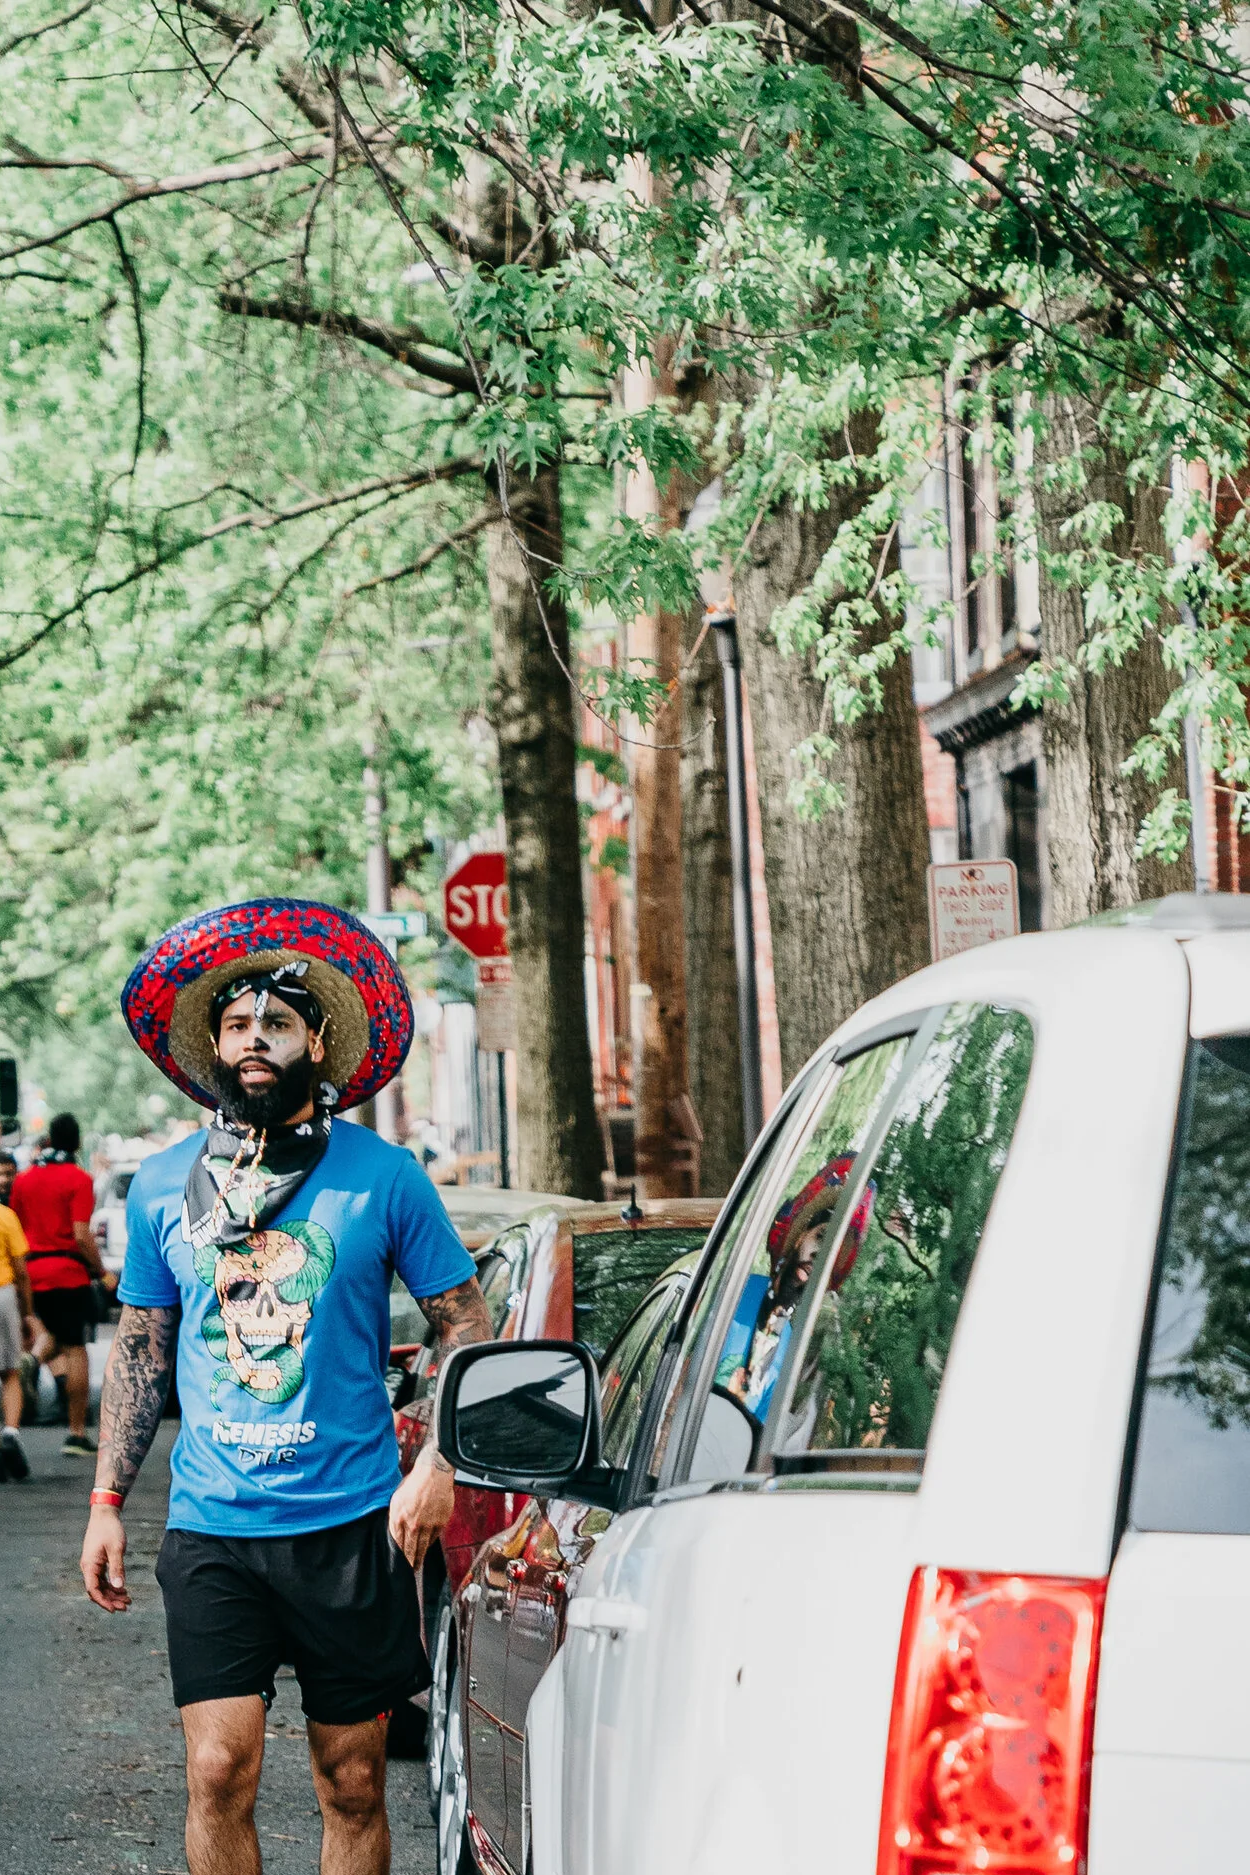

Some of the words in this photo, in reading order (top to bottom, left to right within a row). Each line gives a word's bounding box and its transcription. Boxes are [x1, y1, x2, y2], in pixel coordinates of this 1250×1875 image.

[960, 867, 985, 881] NO
[938, 883, 1009, 897] PARKING
[450, 884, 510, 927] STO
[212, 1420, 317, 1446] NEMESIS
[238, 1445, 298, 1466] DTLR
